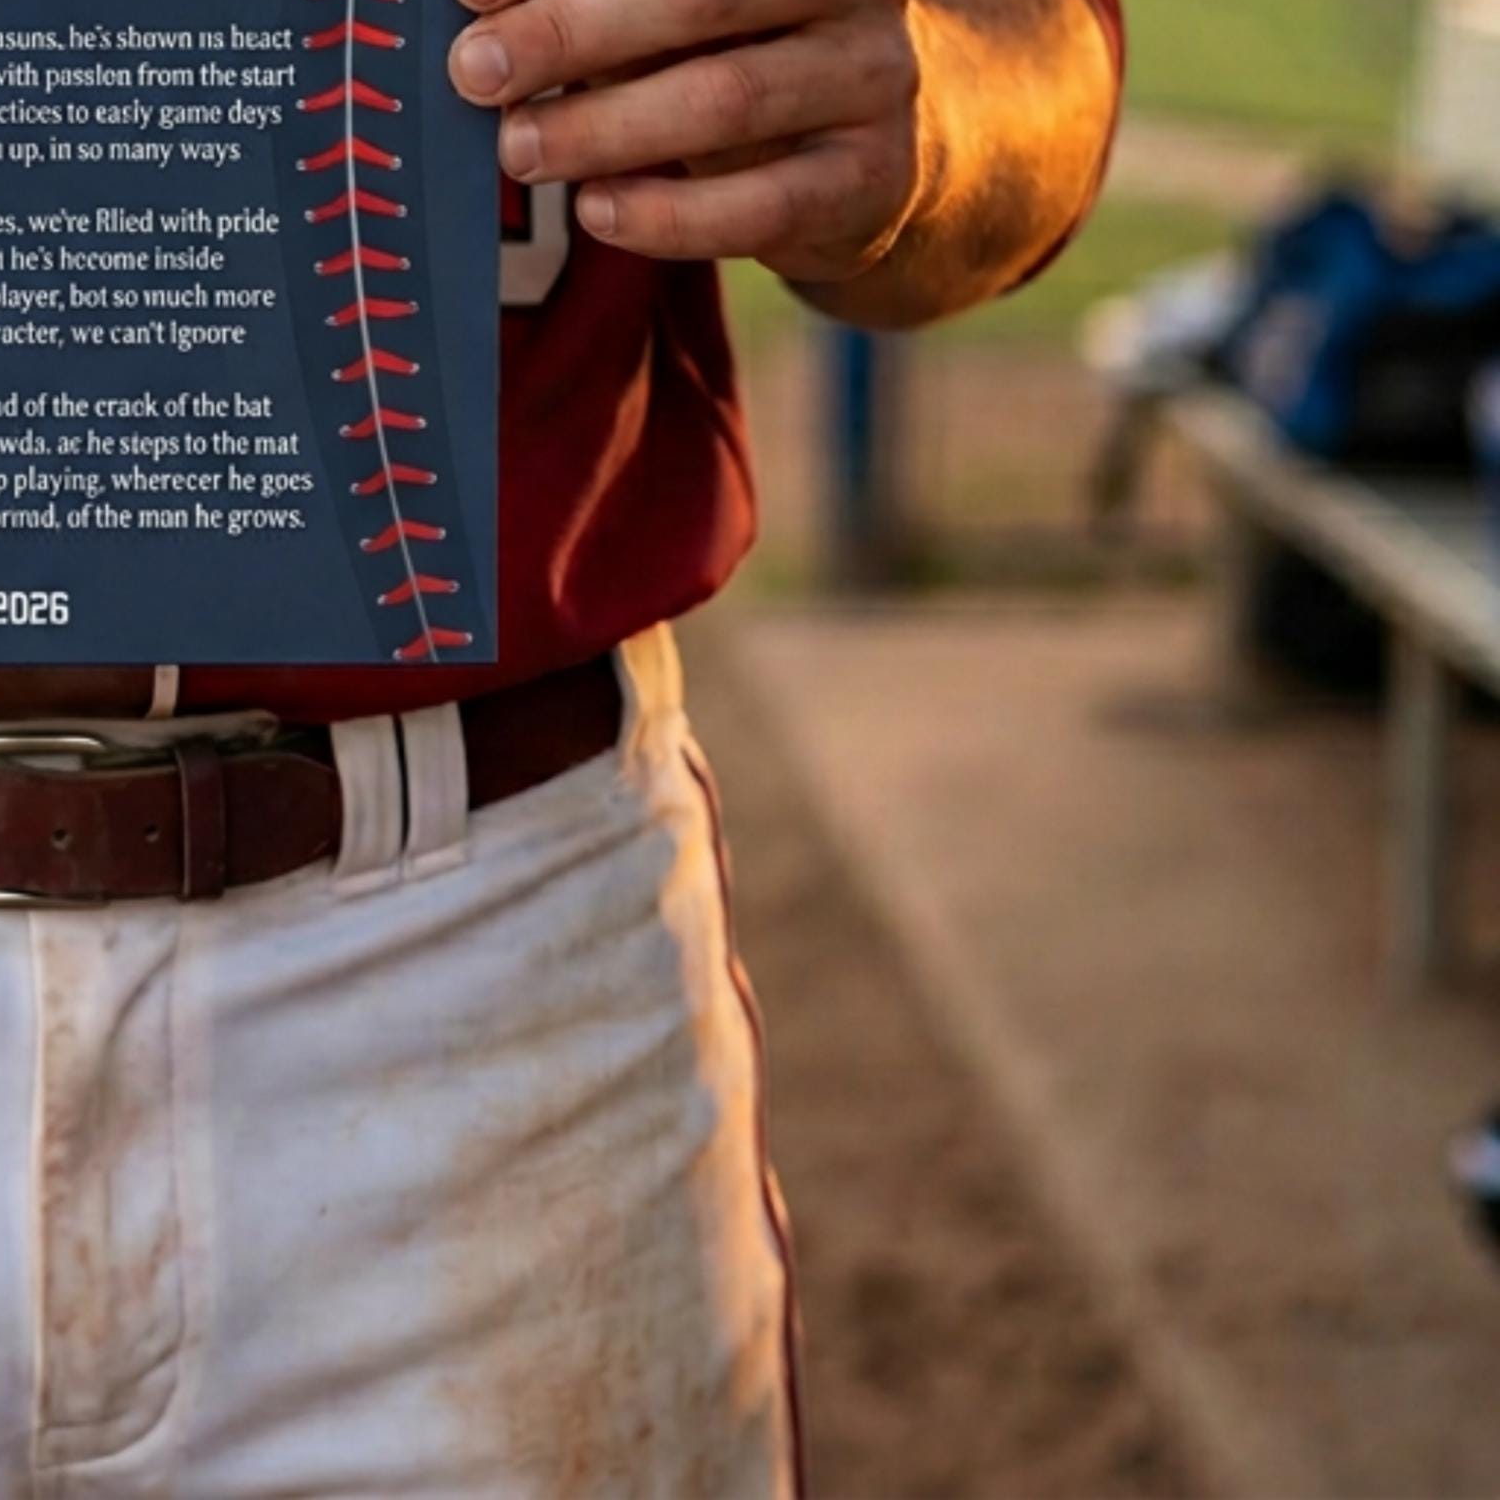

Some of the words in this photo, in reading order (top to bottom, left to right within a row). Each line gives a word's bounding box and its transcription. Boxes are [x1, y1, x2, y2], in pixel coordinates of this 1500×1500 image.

[137, 61, 195, 87] from
[199, 61, 238, 87] the
[241, 64, 295, 87] start
[66, 103, 90, 124] to
[158, 105, 223, 130] game
[50, 136, 72, 160] in
[77, 143, 104, 161] so
[109, 142, 173, 168] many
[180, 142, 241, 168] ways
[159, 207, 213, 233] with
[216, 207, 280, 240] pride
[10, 246, 54, 271] he's
[154, 245, 225, 270] inside
[112, 289, 139, 308] so
[214, 289, 276, 308] more
[70, 325, 104, 344] we
[23, 392, 48, 417] of
[51, 392, 90, 418] the
[163, 392, 190, 417] of
[233, 392, 272, 418] bat
[86, 429, 115, 455] he
[184, 433, 208, 455] to
[212, 430, 250, 455] the
[254, 433, 299, 455] mat
[228, 465, 256, 492] he
[67, 503, 92, 529] of
[95, 502, 133, 529] the
[195, 502, 223, 529] he
